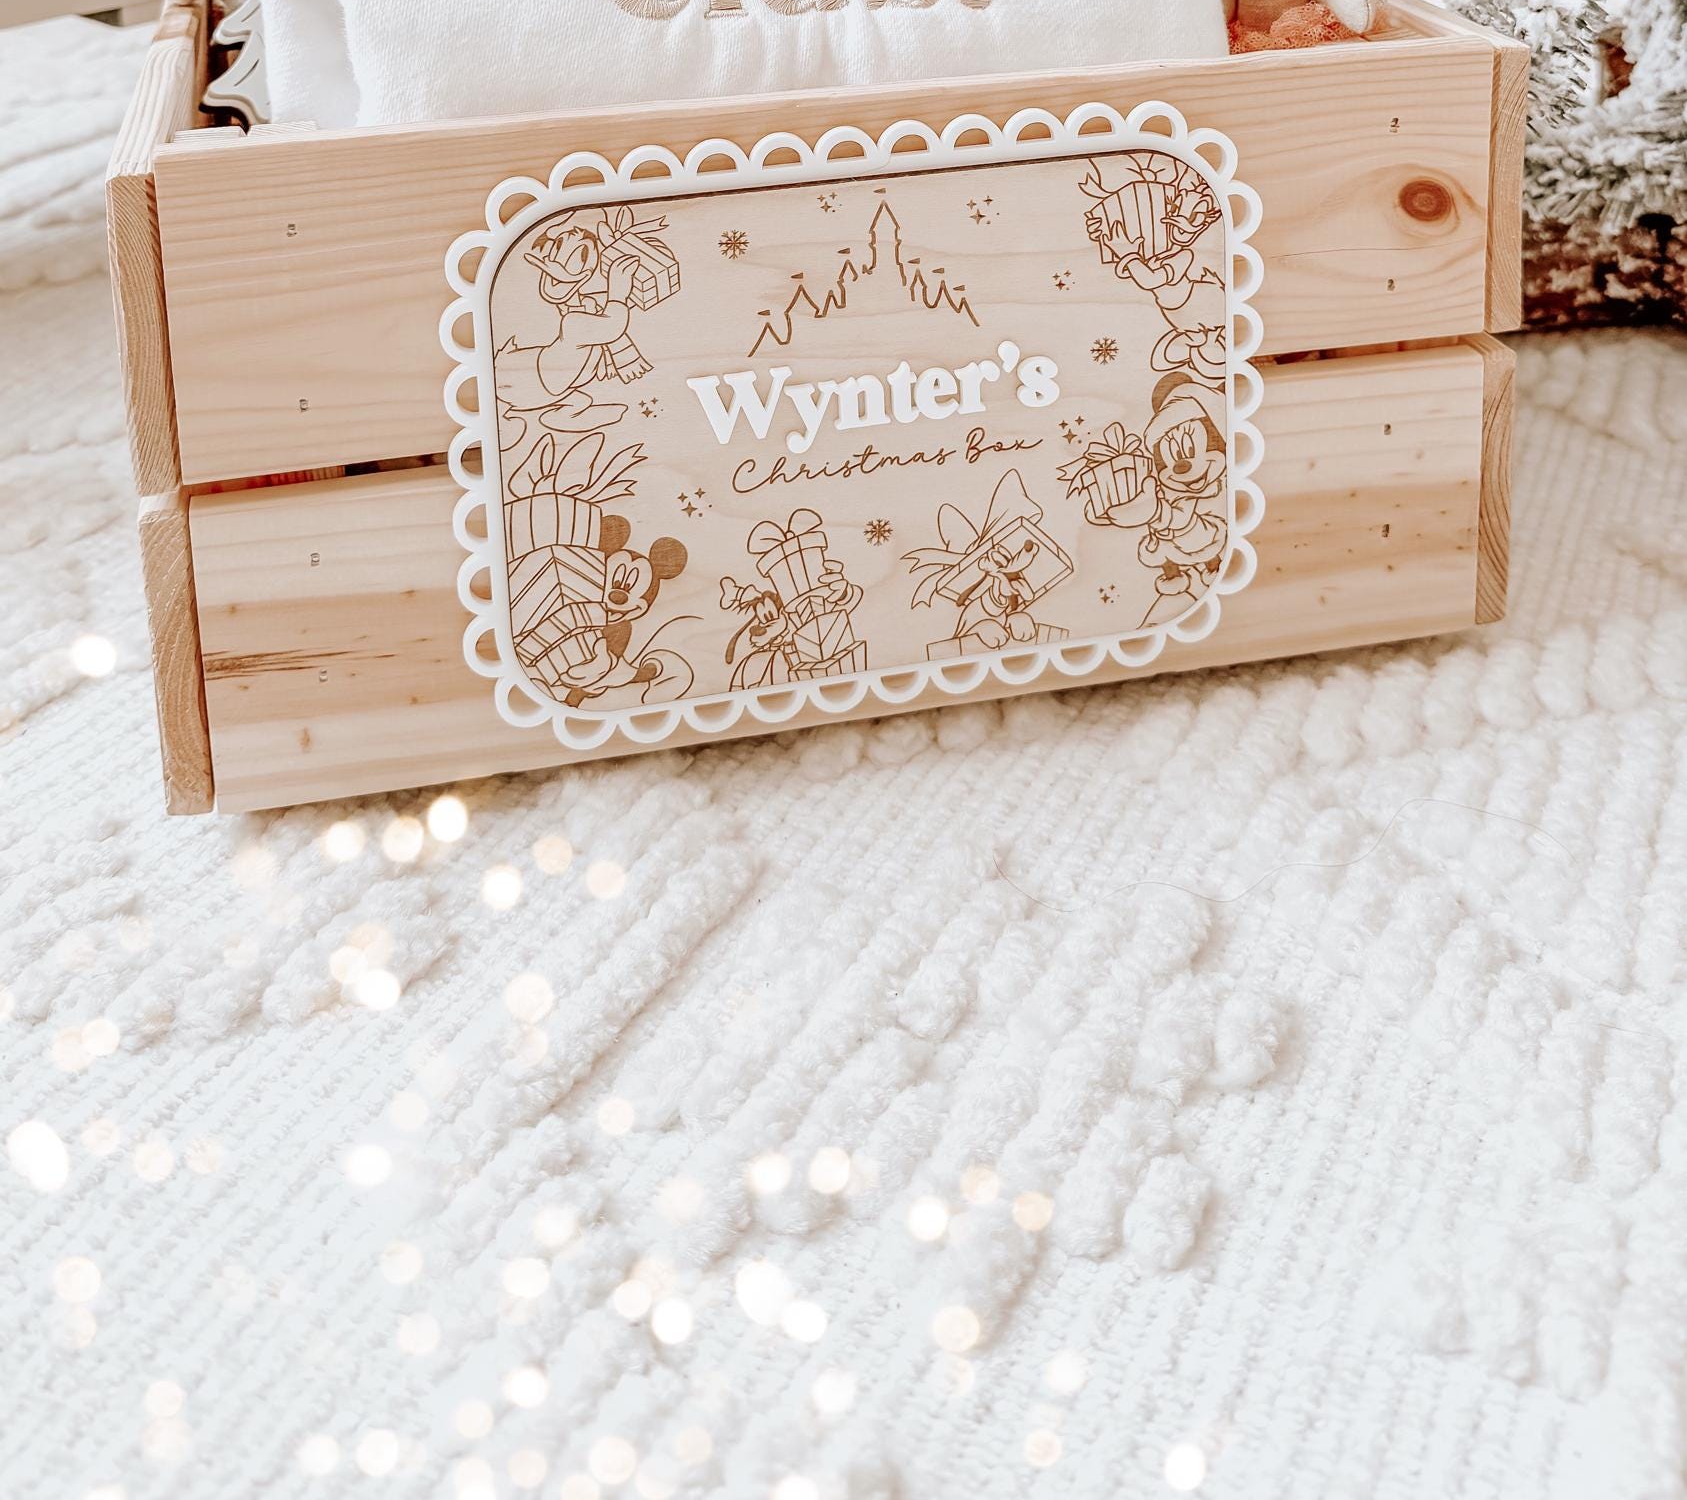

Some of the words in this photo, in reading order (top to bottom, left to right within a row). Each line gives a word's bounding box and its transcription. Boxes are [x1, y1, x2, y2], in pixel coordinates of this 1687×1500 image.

[686, 340, 1061, 454] Wynter's
[732, 444, 957, 494] Christmas
[964, 426, 1043, 463] Box
